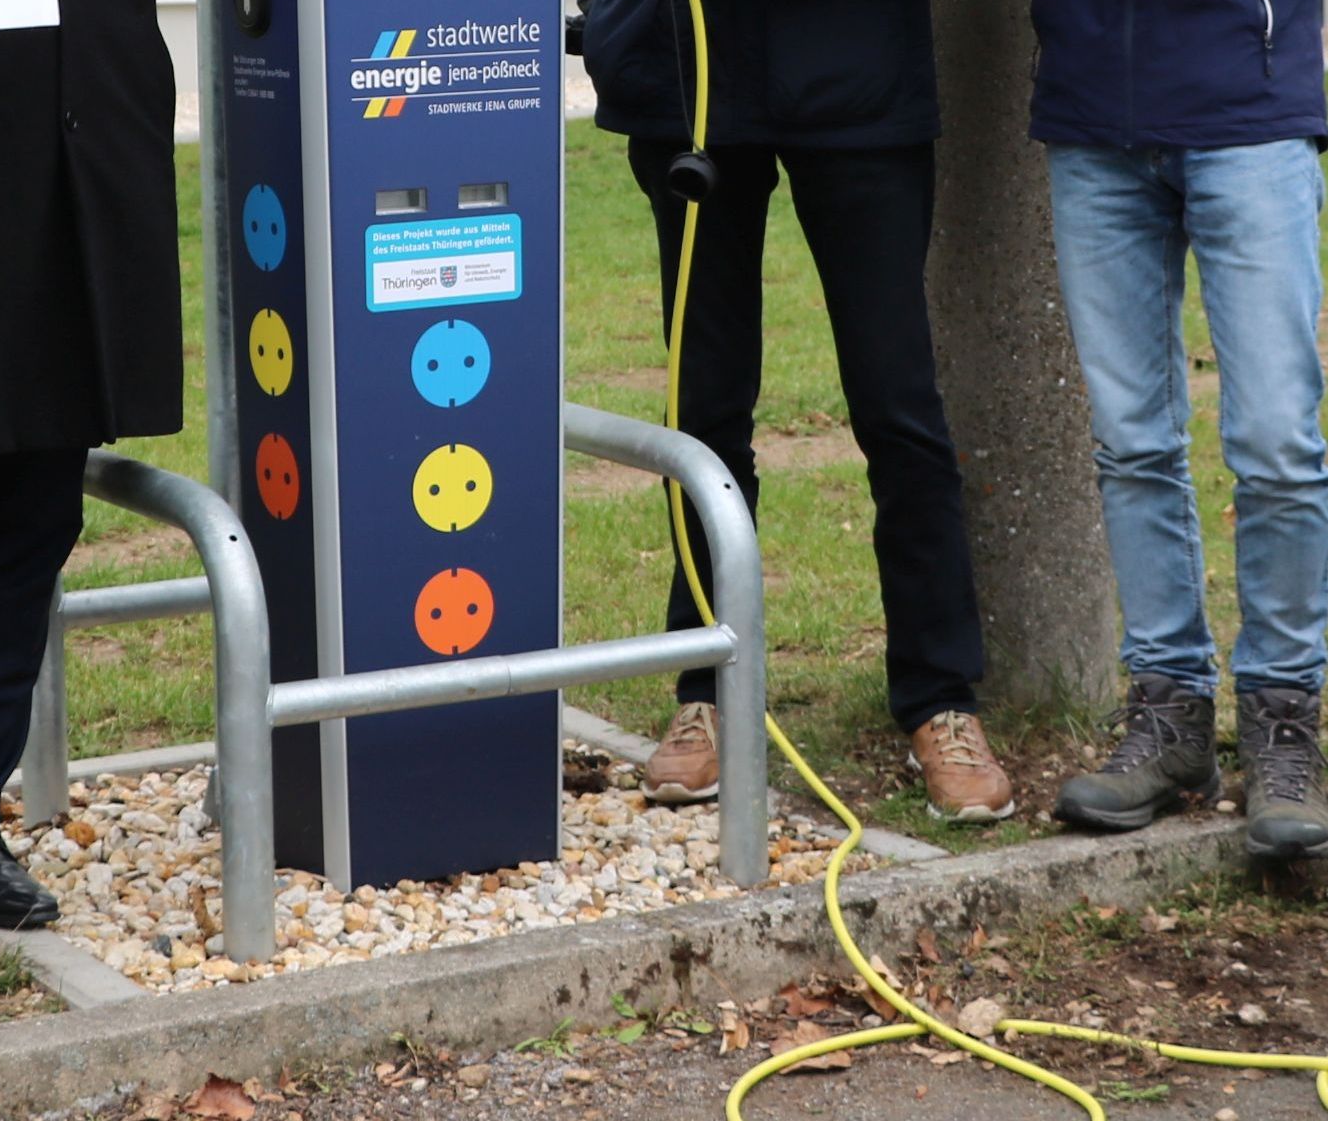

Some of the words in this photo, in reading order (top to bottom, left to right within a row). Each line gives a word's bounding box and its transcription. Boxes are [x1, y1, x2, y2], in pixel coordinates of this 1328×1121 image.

[427, 17, 540, 47] stadtwerke
[350, 60, 441, 93] energie
[447, 59, 540, 86] jena-pößneck
[428, 100, 483, 115] STADTWERKE
[484, 99, 506, 111] JENA
[507, 97, 541, 110] GRUPPE
[373, 231, 400, 242] Dieses
[403, 229, 433, 241] Projekt
[436, 226, 461, 237] wurde
[463, 226, 478, 235] aus
[481, 222, 510, 233] Mitteln
[373, 245, 388, 255] des
[390, 242, 430, 254] Freistaats
[432, 239, 472, 251] Thüringen
[474, 236, 514, 248] gefördert.
[411, 267, 437, 276] Freistaat
[382, 276, 438, 290] Thüringen
